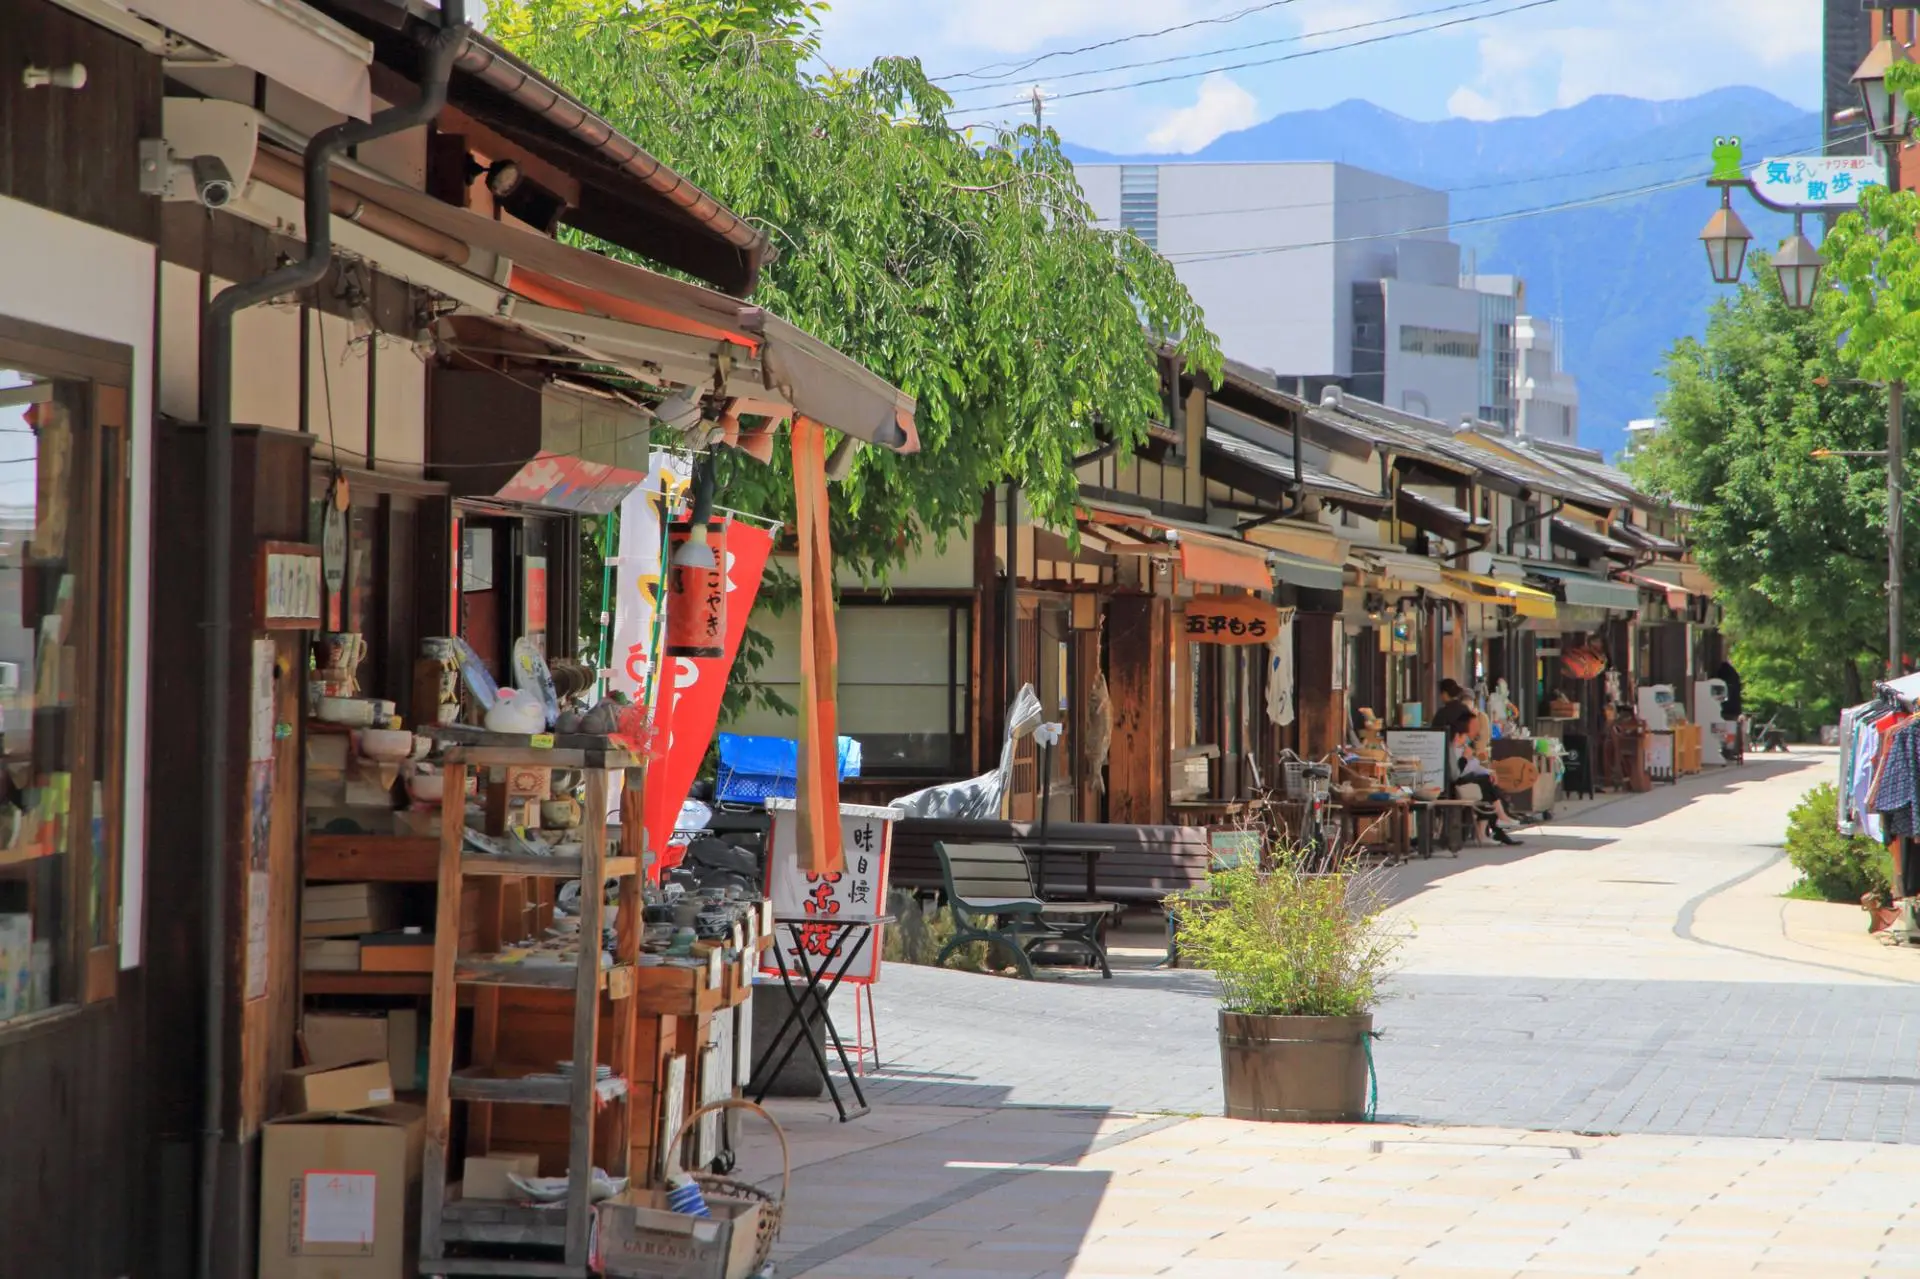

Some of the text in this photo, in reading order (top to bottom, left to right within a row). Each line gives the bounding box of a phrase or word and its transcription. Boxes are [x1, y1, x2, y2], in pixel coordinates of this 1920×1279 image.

[1186, 615, 1266, 636] 五平もち
[848, 822, 873, 904] 味自慢
